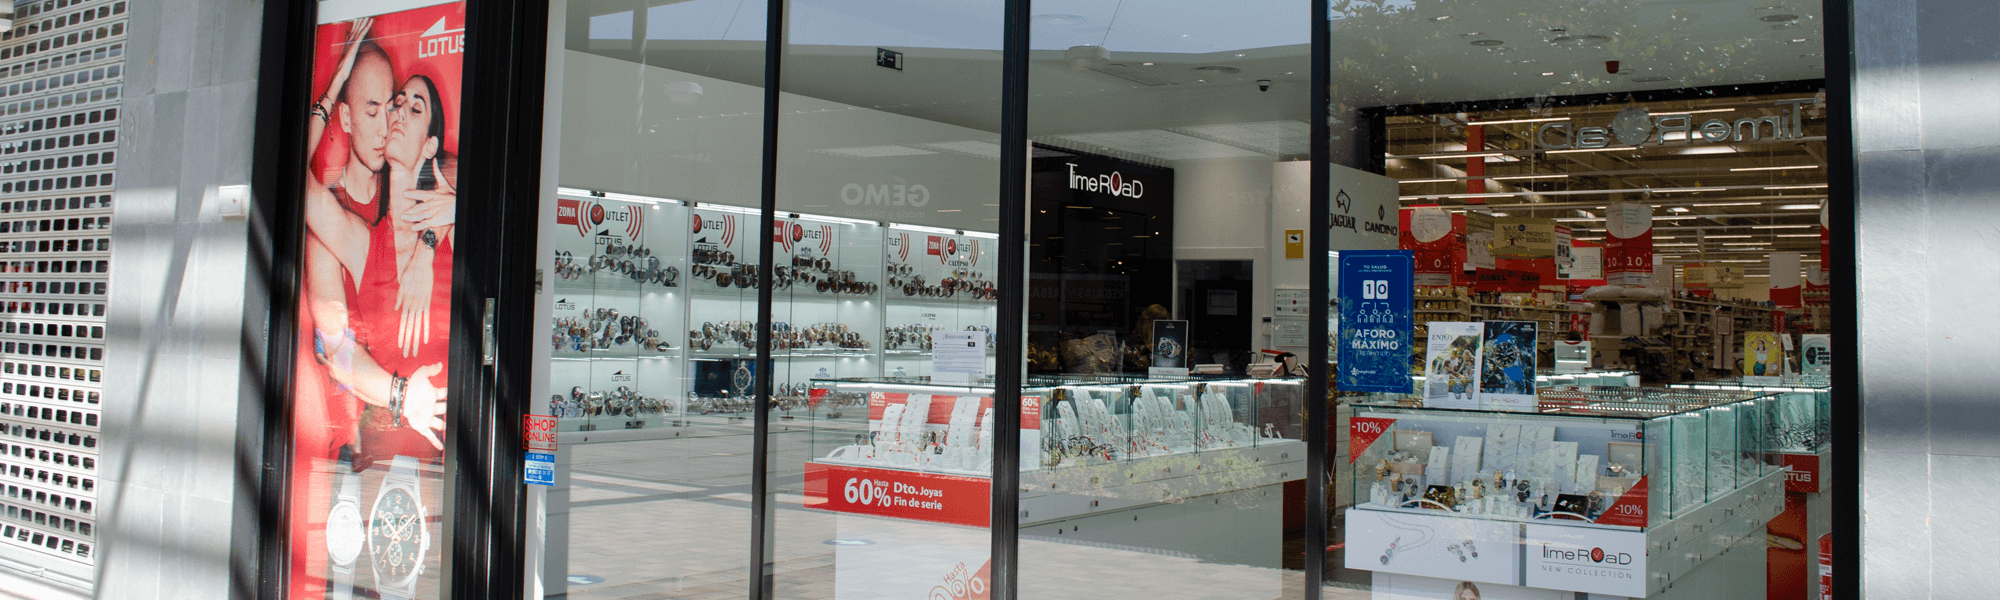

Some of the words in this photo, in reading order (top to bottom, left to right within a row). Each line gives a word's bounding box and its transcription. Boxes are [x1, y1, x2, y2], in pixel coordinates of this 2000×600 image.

[558, 206, 576, 218] ZONA
[1329, 213, 1358, 234] JAGUAR
[1364, 221, 1398, 236] CANDINO
[595, 236, 622, 246] LOTUS
[1366, 284, 1387, 295] 10
[554, 302, 576, 310] LOTUS
[1354, 329, 1396, 338] AFORO
[1352, 338, 1399, 350] MÁXIMO
[871, 391, 885, 400] 60%
[1022, 398, 1038, 408] 60%
[526, 418, 556, 432] SHOP
[1352, 422, 1381, 434] -10%
[526, 432, 556, 442] ONLINE
[874, 479, 889, 488] Hasta
[844, 478, 892, 507] 60%
[894, 482, 918, 496] Dto.
[920, 488, 943, 498] Joyas
[894, 496, 907, 507] Fin
[908, 498, 920, 508] de
[921, 500, 942, 510] serie
[1615, 504, 1643, 516] -10%
[943, 561, 966, 585] Hasta
[1541, 565, 1562, 573] NEW
[1568, 567, 1632, 579] COLLECTION
